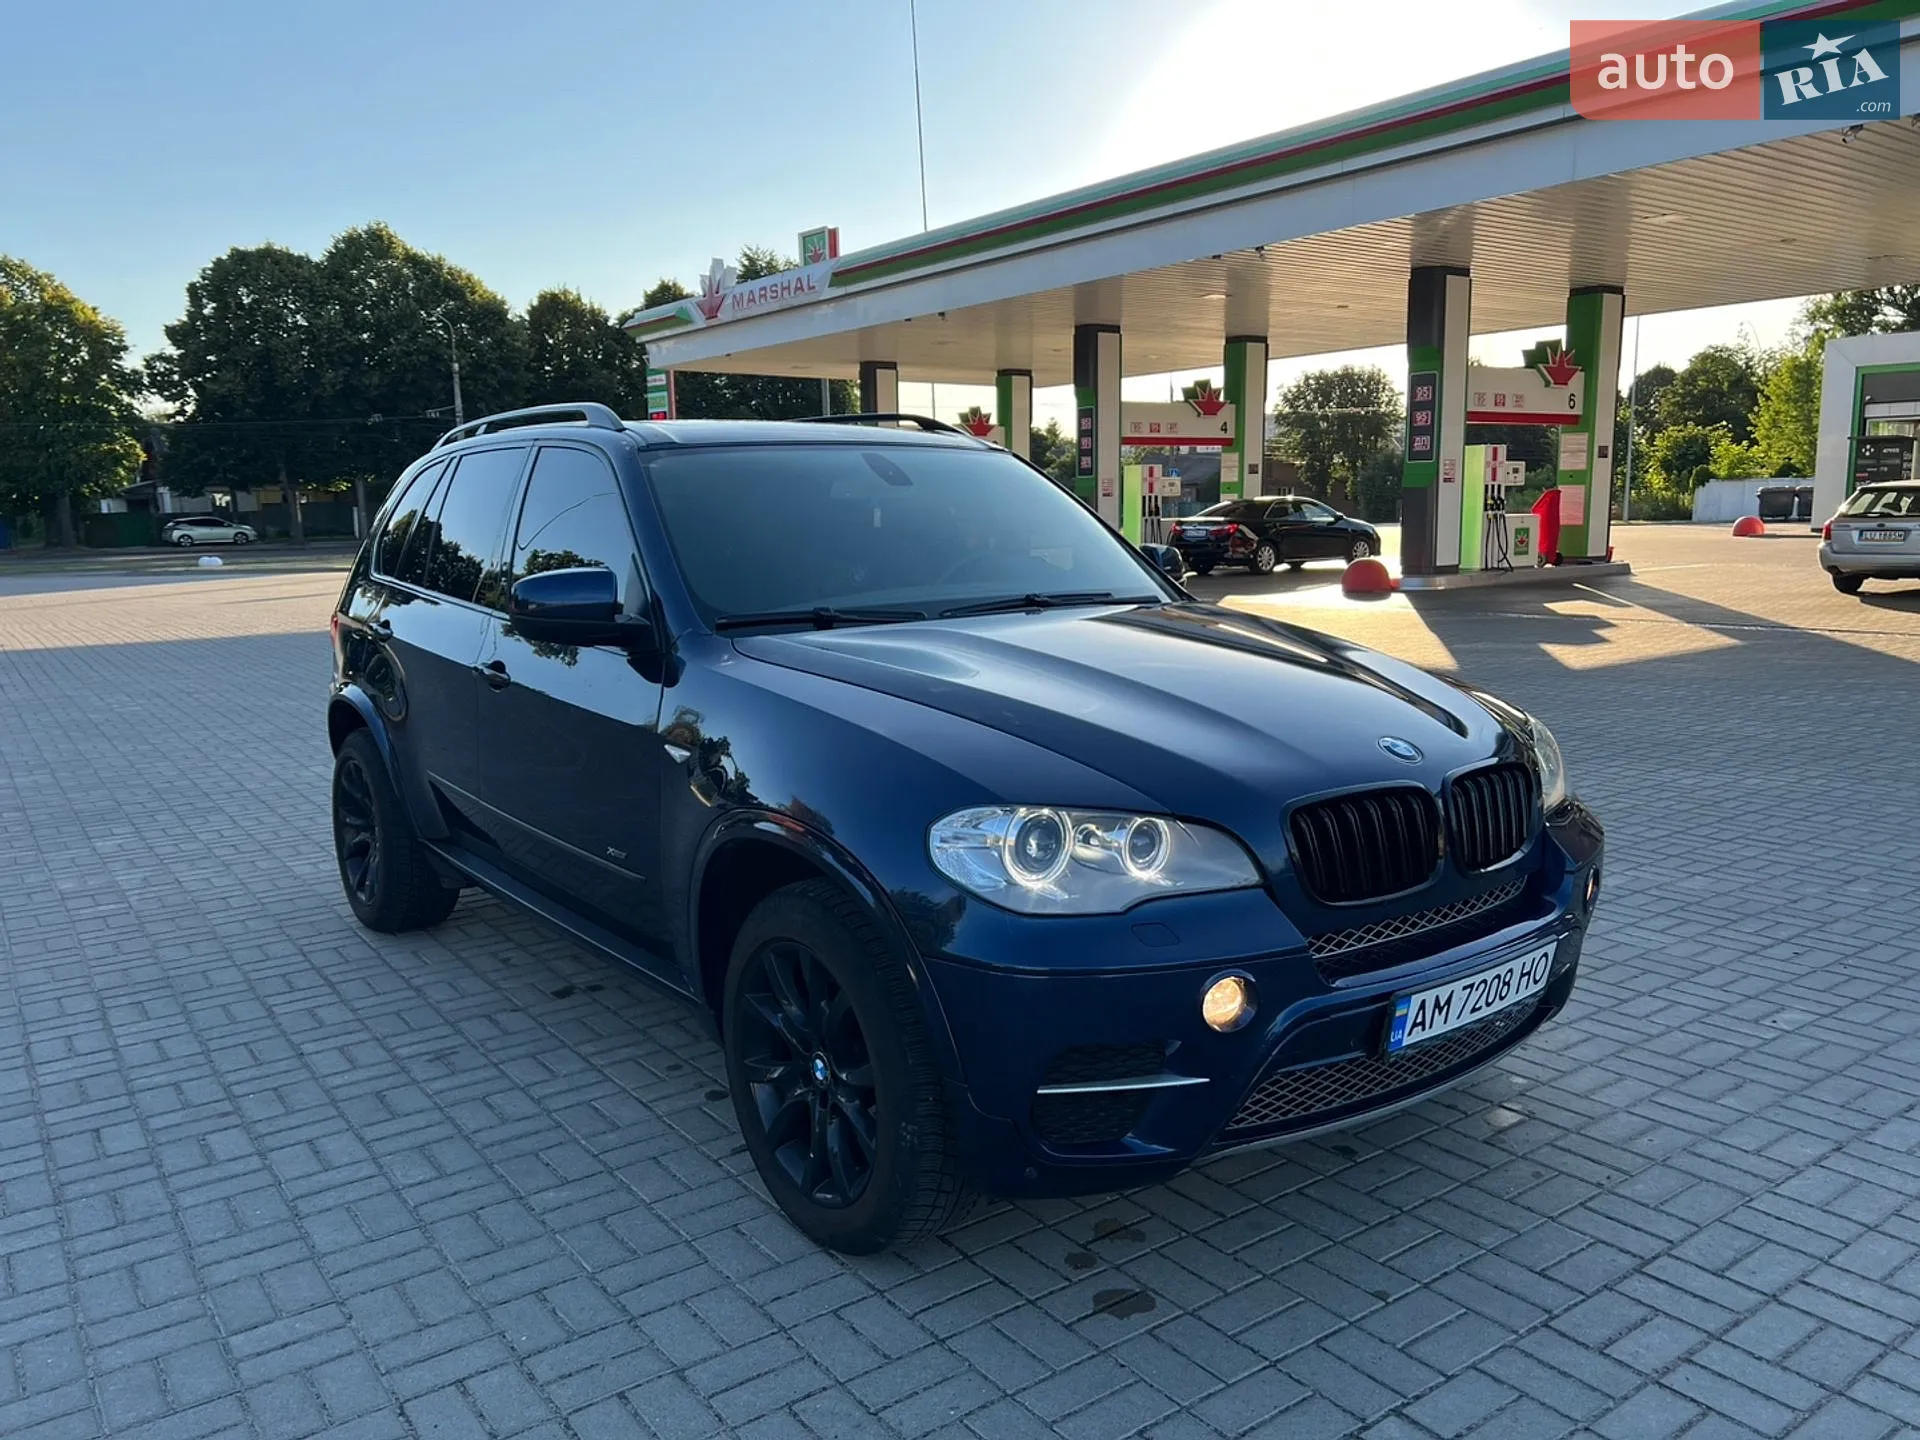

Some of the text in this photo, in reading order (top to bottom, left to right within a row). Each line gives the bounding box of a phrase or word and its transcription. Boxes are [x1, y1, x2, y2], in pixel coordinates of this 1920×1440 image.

[731, 272, 816, 311] MARSHAL
[1568, 393, 1576, 410] 6
[1220, 421, 1228, 434] 4
[1406, 951, 1549, 1037] AM 7208 HO
